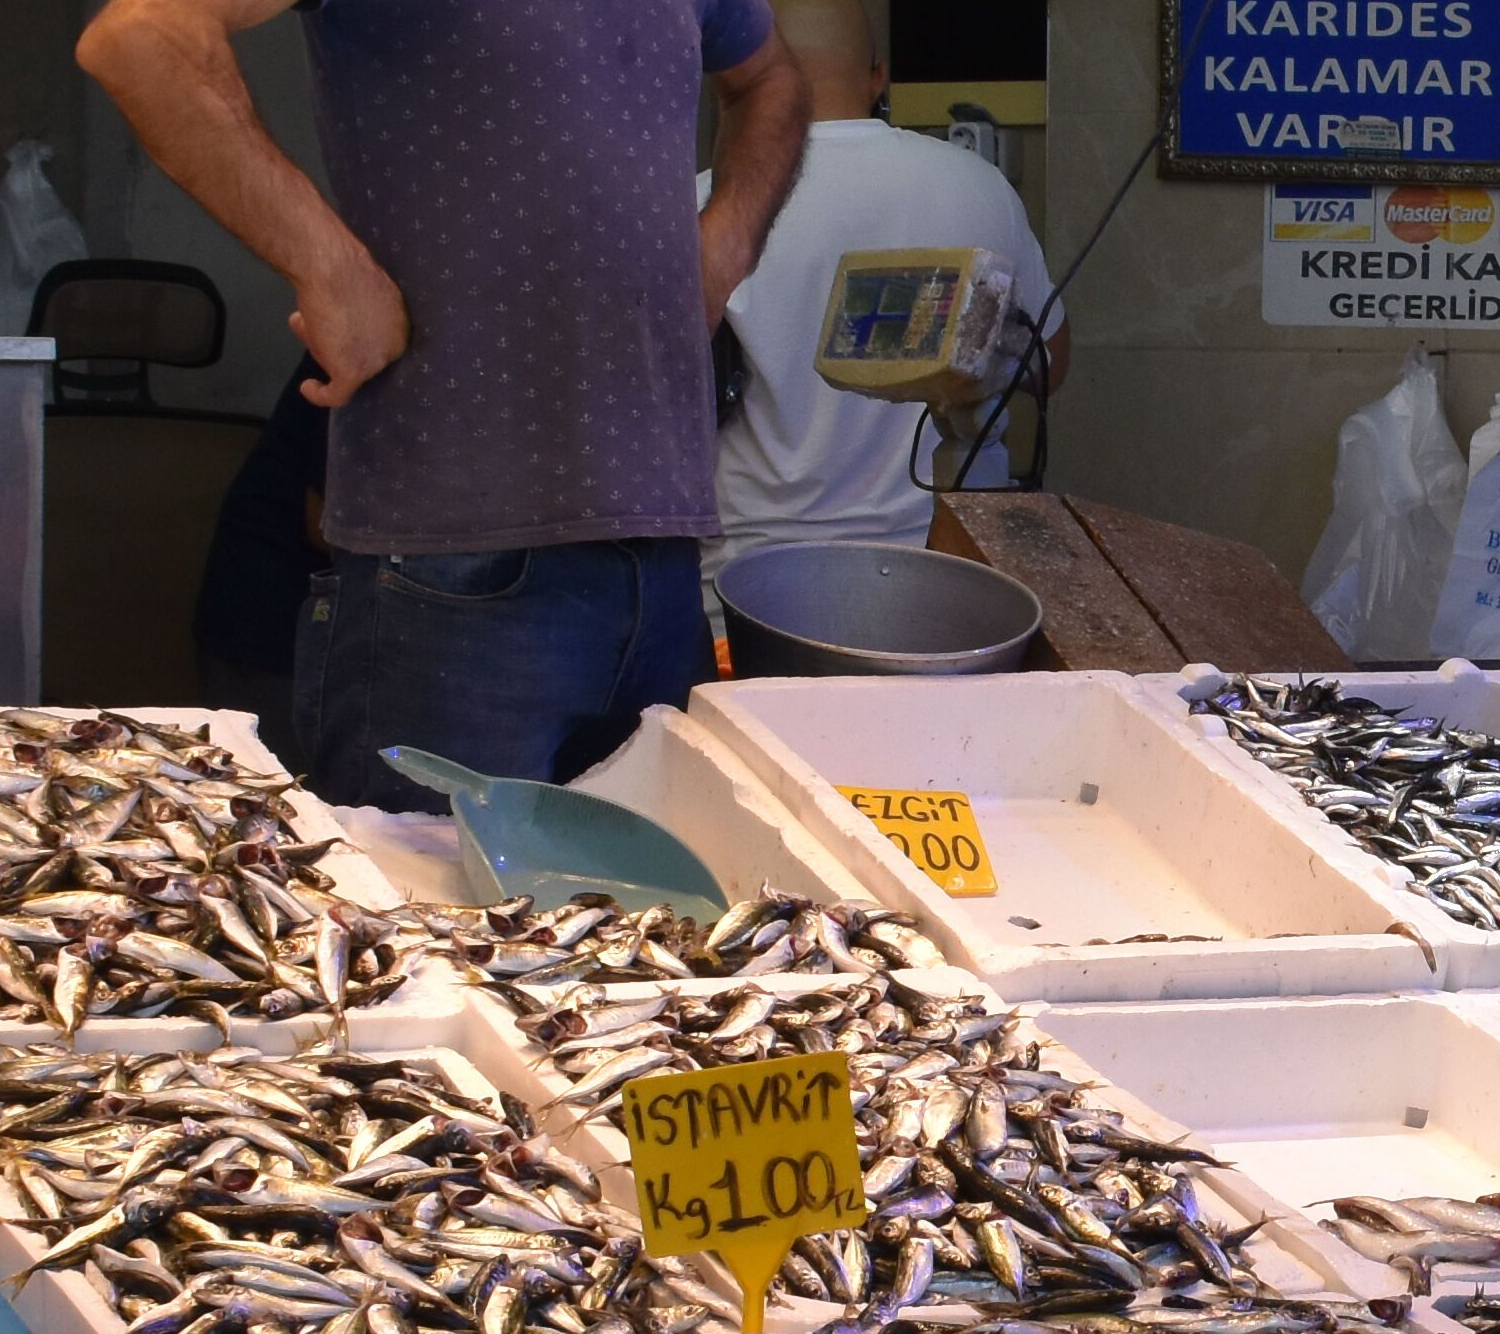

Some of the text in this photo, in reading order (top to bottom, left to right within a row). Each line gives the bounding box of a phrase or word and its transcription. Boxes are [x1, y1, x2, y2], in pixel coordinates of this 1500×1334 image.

[1204, 56, 1493, 96] KALAMAR
[1235, 112, 1456, 152] VARIR
[1293, 200, 1356, 222] VISA
[1386, 205, 1492, 224] MasterCard
[1300, 244, 1431, 280] KREDİ
[643, 1170, 712, 1241] Kg
[716, 1150, 838, 1234] 100
